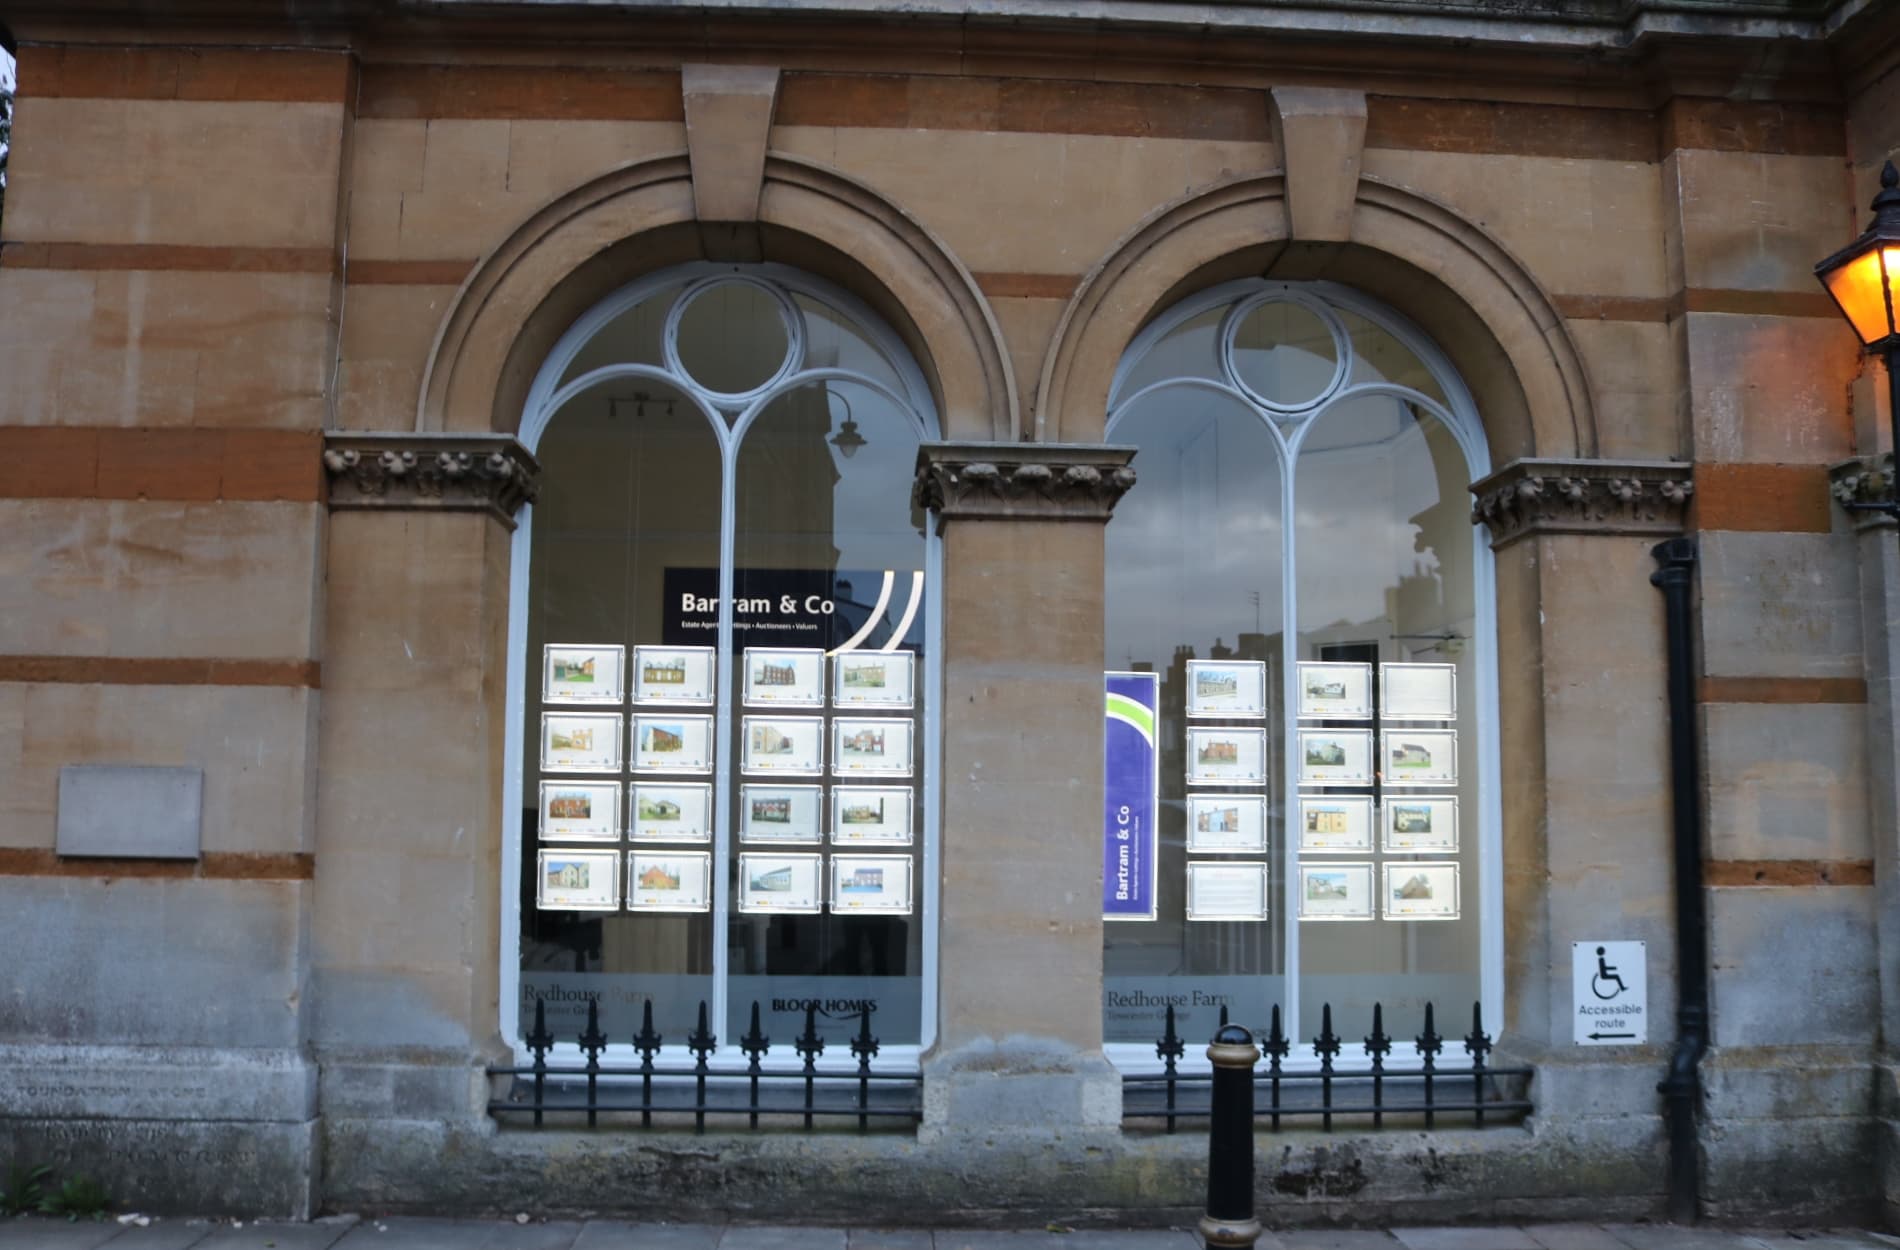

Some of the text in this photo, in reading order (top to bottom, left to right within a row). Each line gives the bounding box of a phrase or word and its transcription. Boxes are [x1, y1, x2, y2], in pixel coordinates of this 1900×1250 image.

[681, 593, 835, 614] Barram & Co
[1116, 806, 1129, 900] Bartram & Co
[524, 984, 605, 1001] Redhouse
[1108, 990, 1235, 1007] Redhouse Farm
[1579, 1004, 1643, 1015] Accessible
[1594, 1019, 1626, 1028] route
